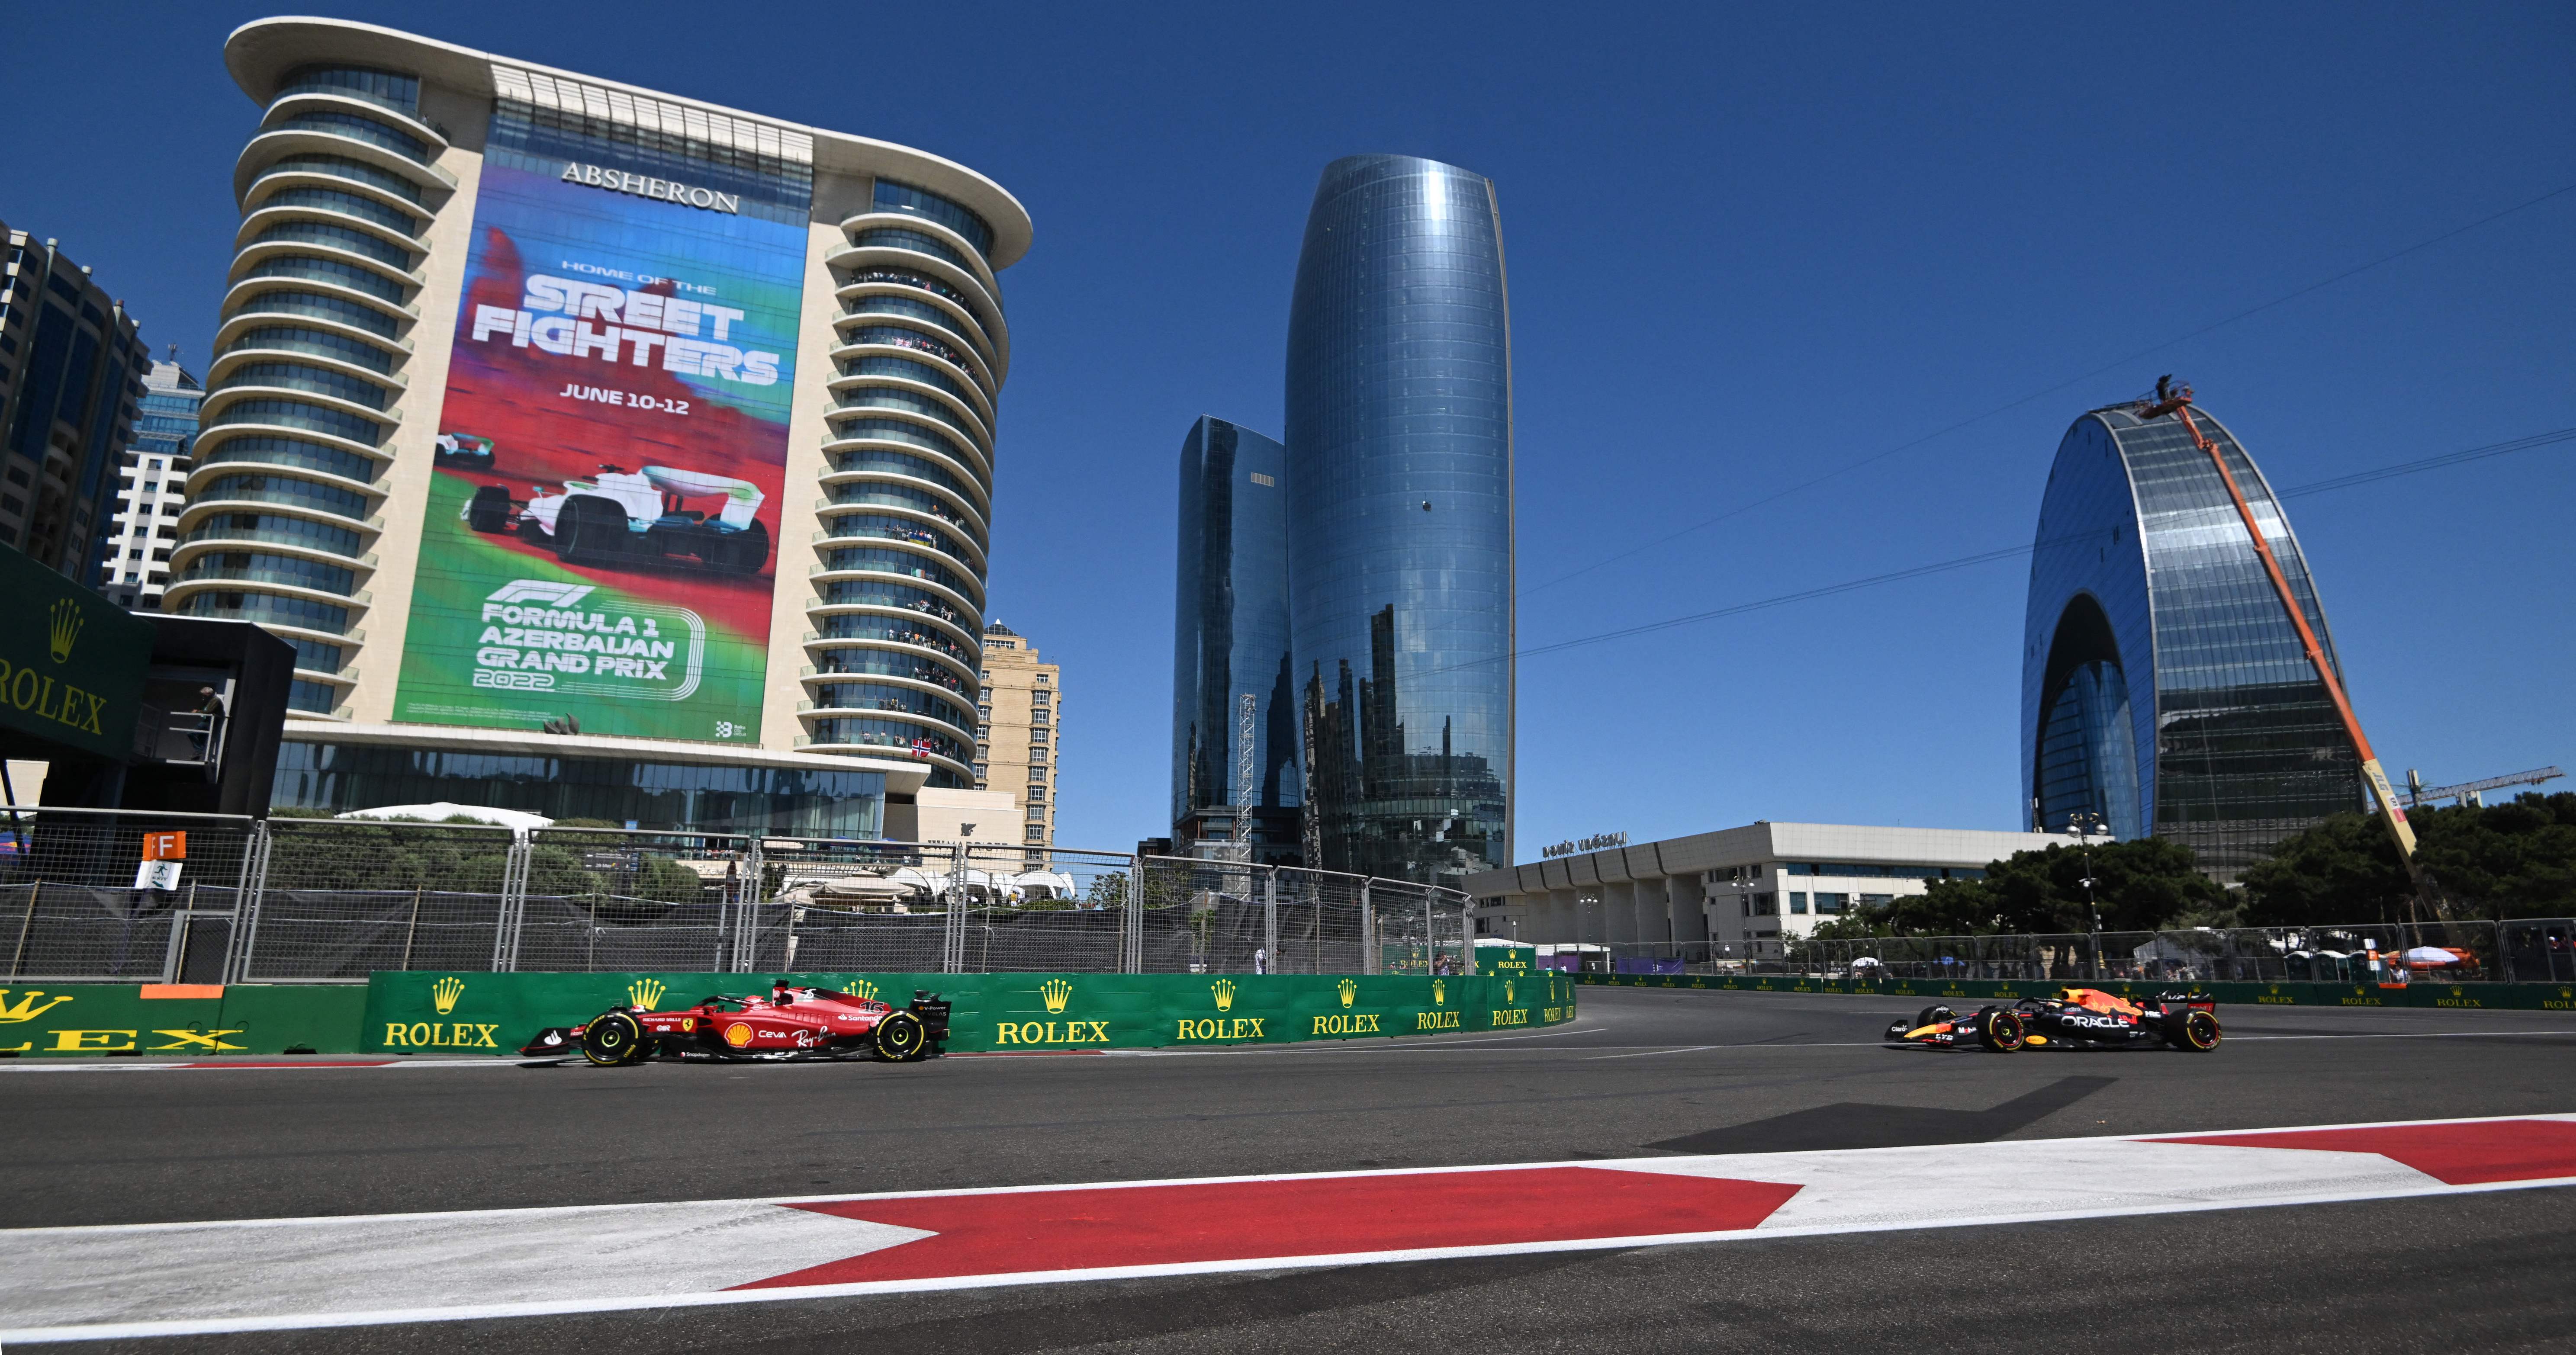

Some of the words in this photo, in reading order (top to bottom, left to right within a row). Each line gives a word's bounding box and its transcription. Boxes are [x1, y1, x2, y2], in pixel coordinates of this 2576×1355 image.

[562, 162, 740, 214] ABSHERON
[562, 260, 633, 280] HOME
[638, 274, 669, 286] OF
[672, 281, 717, 295] THE
[524, 274, 744, 342] STREET
[472, 304, 779, 386] FIGHTERS
[560, 383, 624, 406] JUNE
[627, 393, 690, 415] 10-12
[482, 603, 637, 635] FORMULA
[643, 618, 659, 637] 1
[479, 626, 675, 658] AZERBAIJAN
[476, 646, 590, 673] GRAND
[595, 655, 668, 680] PRIX
[473, 668, 556, 692] 2022
[2372, 772, 2389, 791] JLG
[159, 835, 175, 857] F
[859, 1001, 884, 1014] 16
[2258, 995, 2294, 1004] ROLEX
[2437, 999, 2482, 1007] ROLEX
[2543, 1000, 2576, 1009] ROL
[1312, 1014, 1380, 1034] ROLEX
[1417, 1011, 1460, 1030] ROLEX
[1492, 1009, 1528, 1026] ROLEX
[1544, 1007, 1561, 1022] ROLEX
[2061, 1015, 2129, 1027] ORACLE
[383, 1022, 499, 1047] ROLEX
[791, 1025, 836, 1047] Ray-Ban
[996, 1021, 1110, 1044] ROLEX
[1176, 1018, 1265, 1039] ROLEX
